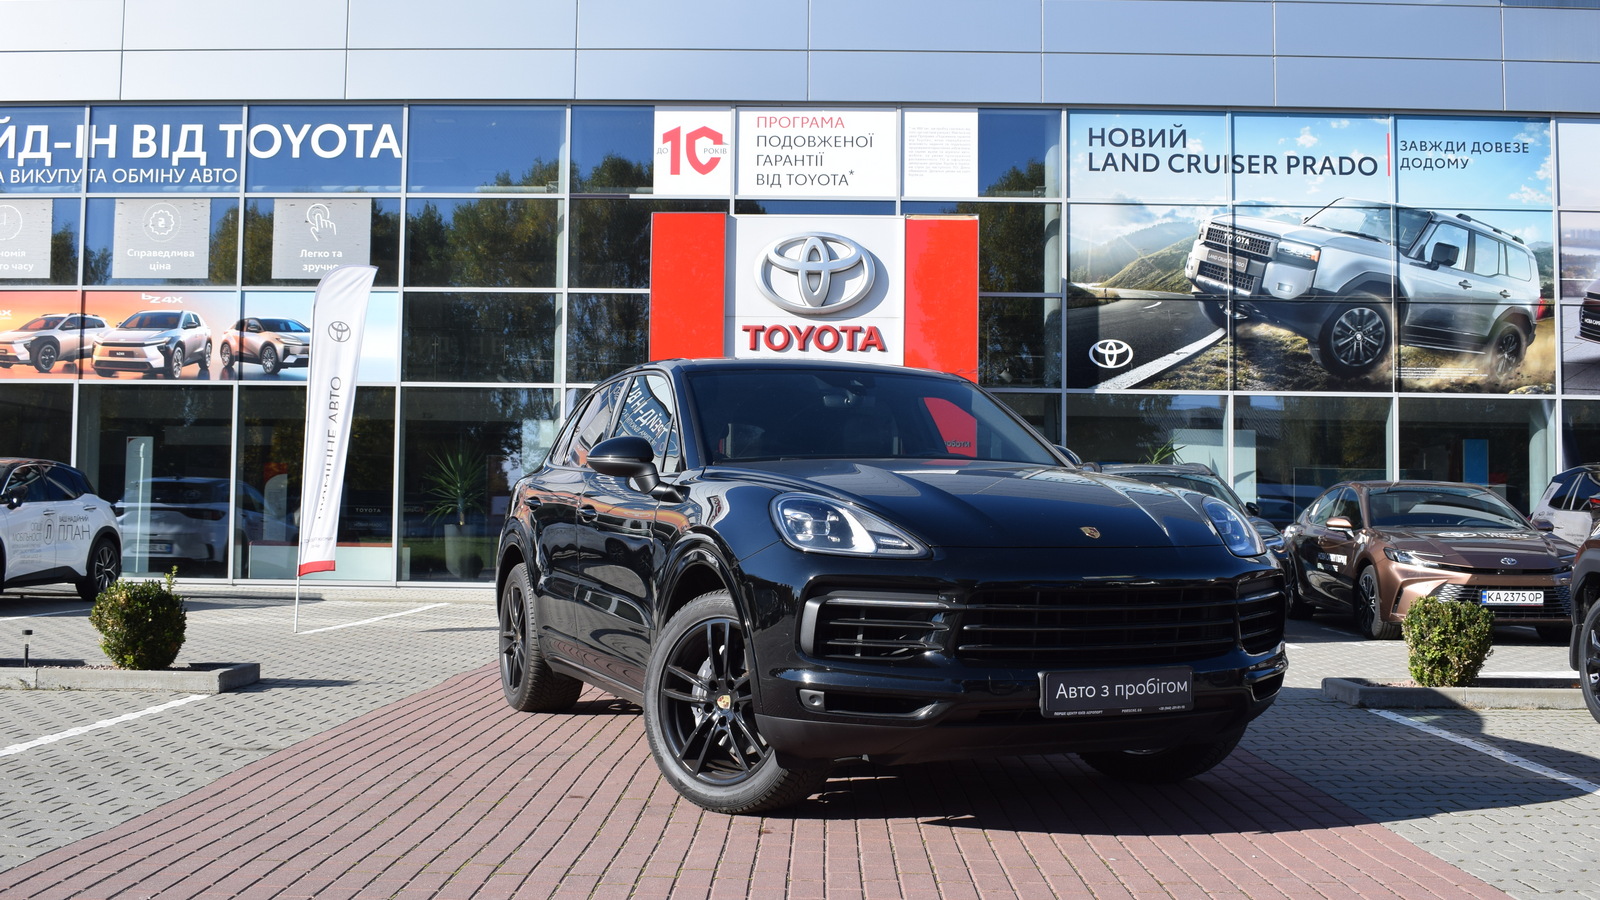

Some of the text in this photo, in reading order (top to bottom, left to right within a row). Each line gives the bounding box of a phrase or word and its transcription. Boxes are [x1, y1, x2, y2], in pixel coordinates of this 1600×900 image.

[757, 116, 845, 129] ПРОГРАМА
[756, 133, 875, 150] ПОДОВЖЕНОЇ
[1088, 124, 1187, 149] НОВИЙ
[132, 124, 207, 166] ВІД
[219, 123, 402, 159] TOYOTA
[656, 147, 669, 155] ДО
[703, 147, 728, 155] РОКІВ
[1400, 140, 1529, 155] ЗАВЖДИ ДОВЕЗЕ
[756, 151, 825, 167] ГАРАНТІЇ
[1088, 152, 1379, 176] LAND CRUISER PRADO
[1400, 157, 1469, 171] ДОДОМУ
[10, 168, 83, 184] ВИКУПУ
[88, 168, 107, 183] ТА
[112, 168, 186, 183] ОБМІНУ
[189, 168, 238, 183] АВТО
[756, 173, 782, 188] ВІД
[127, 248, 195, 259] Справедлива
[300, 249, 330, 258] Легко
[12, 264, 34, 272] часу
[149, 261, 171, 271] ціна
[141, 293, 183, 304] bZ4X
[742, 324, 886, 352] TOYOTA
[328, 376, 342, 424] АВТО
[58, 524, 91, 540] ПЛАН
[1487, 592, 1543, 602] KA 2375 OP
[1055, 677, 1188, 700] Авто з пробігом
